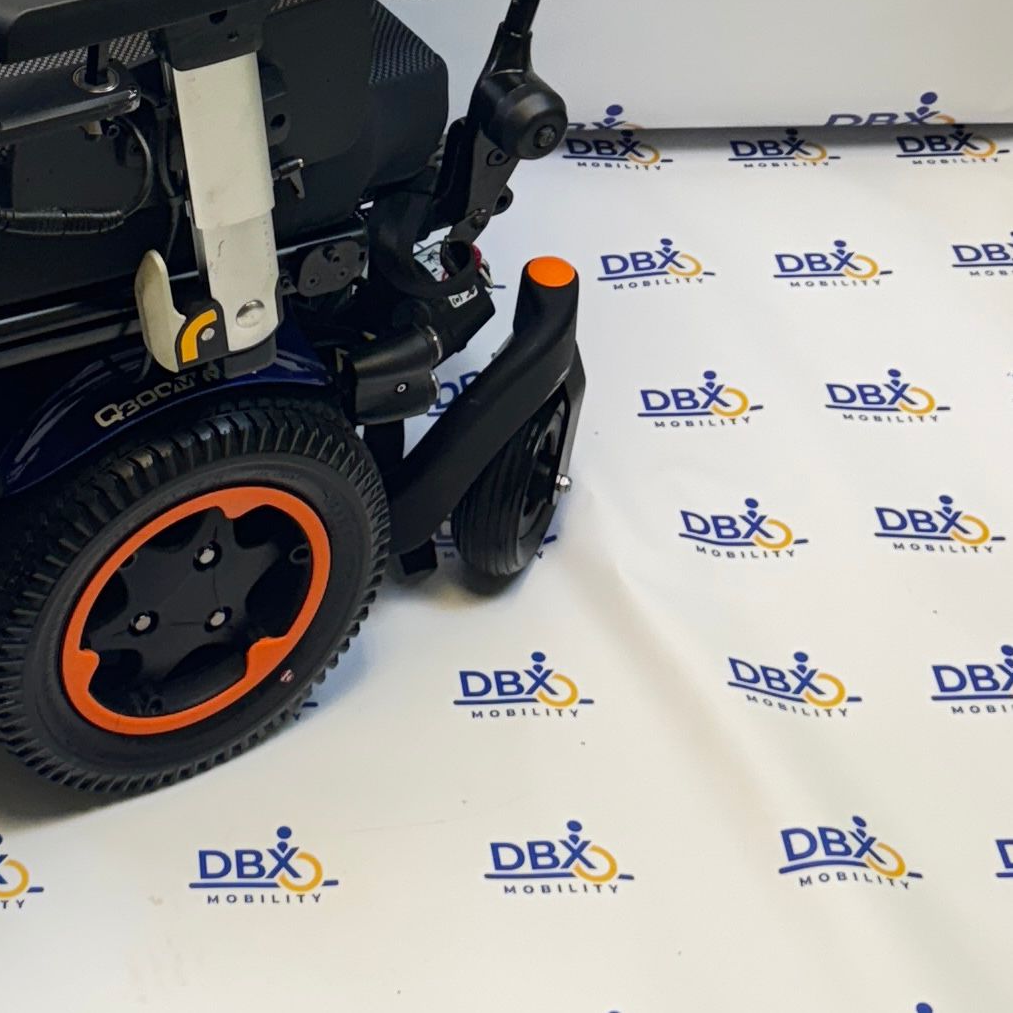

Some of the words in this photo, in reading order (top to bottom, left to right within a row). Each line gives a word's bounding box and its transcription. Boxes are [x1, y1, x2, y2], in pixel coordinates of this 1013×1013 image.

[566, 138, 644, 155] DBX
[730, 140, 806, 156] DBX
[897, 133, 973, 151] DBX
[578, 162, 661, 170] MOBILITY
[600, 250, 686, 273] DBX
[774, 252, 859, 273] DBX
[952, 243, 1013, 266] DB
[613, 278, 703, 290] MOBILITY
[790, 279, 880, 287] MOBILITY
[640, 386, 730, 411] DBX
[826, 382, 918, 406] DBX
[655, 416, 749, 427] MOBILITY
[843, 414, 937, 422] MOBILITY
[681, 511, 775, 540] DBX
[875, 507, 972, 534] DBX
[696, 545, 794, 558] MOBILITY
[893, 543, 992, 553] MOBILITY
[459, 670, 558, 698] DBX
[729, 657, 826, 695] DBX
[472, 708, 578, 718] MOBILITY
[746, 693, 847, 717] MOBILITY
[780, 827, 887, 864] DBX
[199, 848, 301, 879] DBX
[490, 841, 596, 871] DBX
[504, 884, 617, 894] MOBILITY
[799, 873, 909, 890] MOBILITY
[207, 893, 320, 904] MOBILITY
